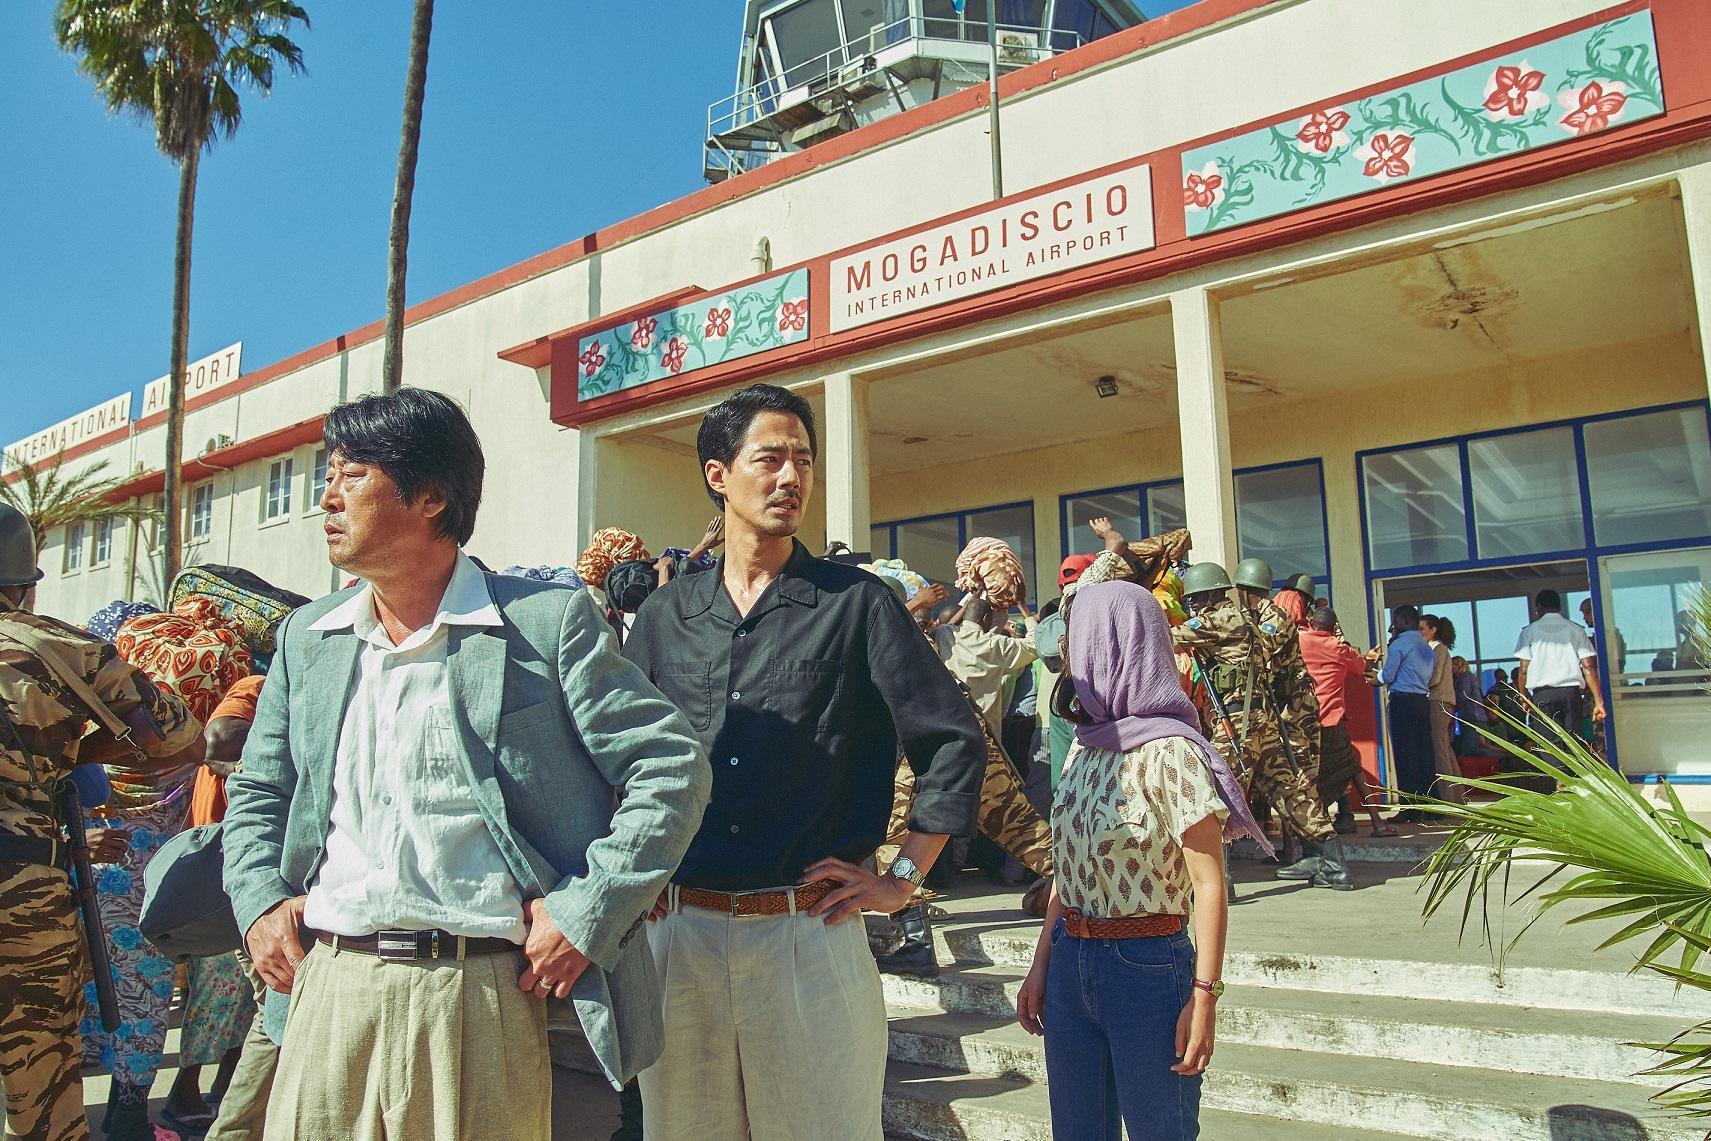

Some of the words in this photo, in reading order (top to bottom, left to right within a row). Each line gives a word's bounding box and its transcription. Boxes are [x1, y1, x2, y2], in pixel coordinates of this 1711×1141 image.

[847, 184, 1128, 294] MOGADISCIO
[847, 259, 1010, 317] INTERNATIONAL
[1025, 225, 1129, 268] AIRPORT
[147, 351, 235, 411] AIPORT
